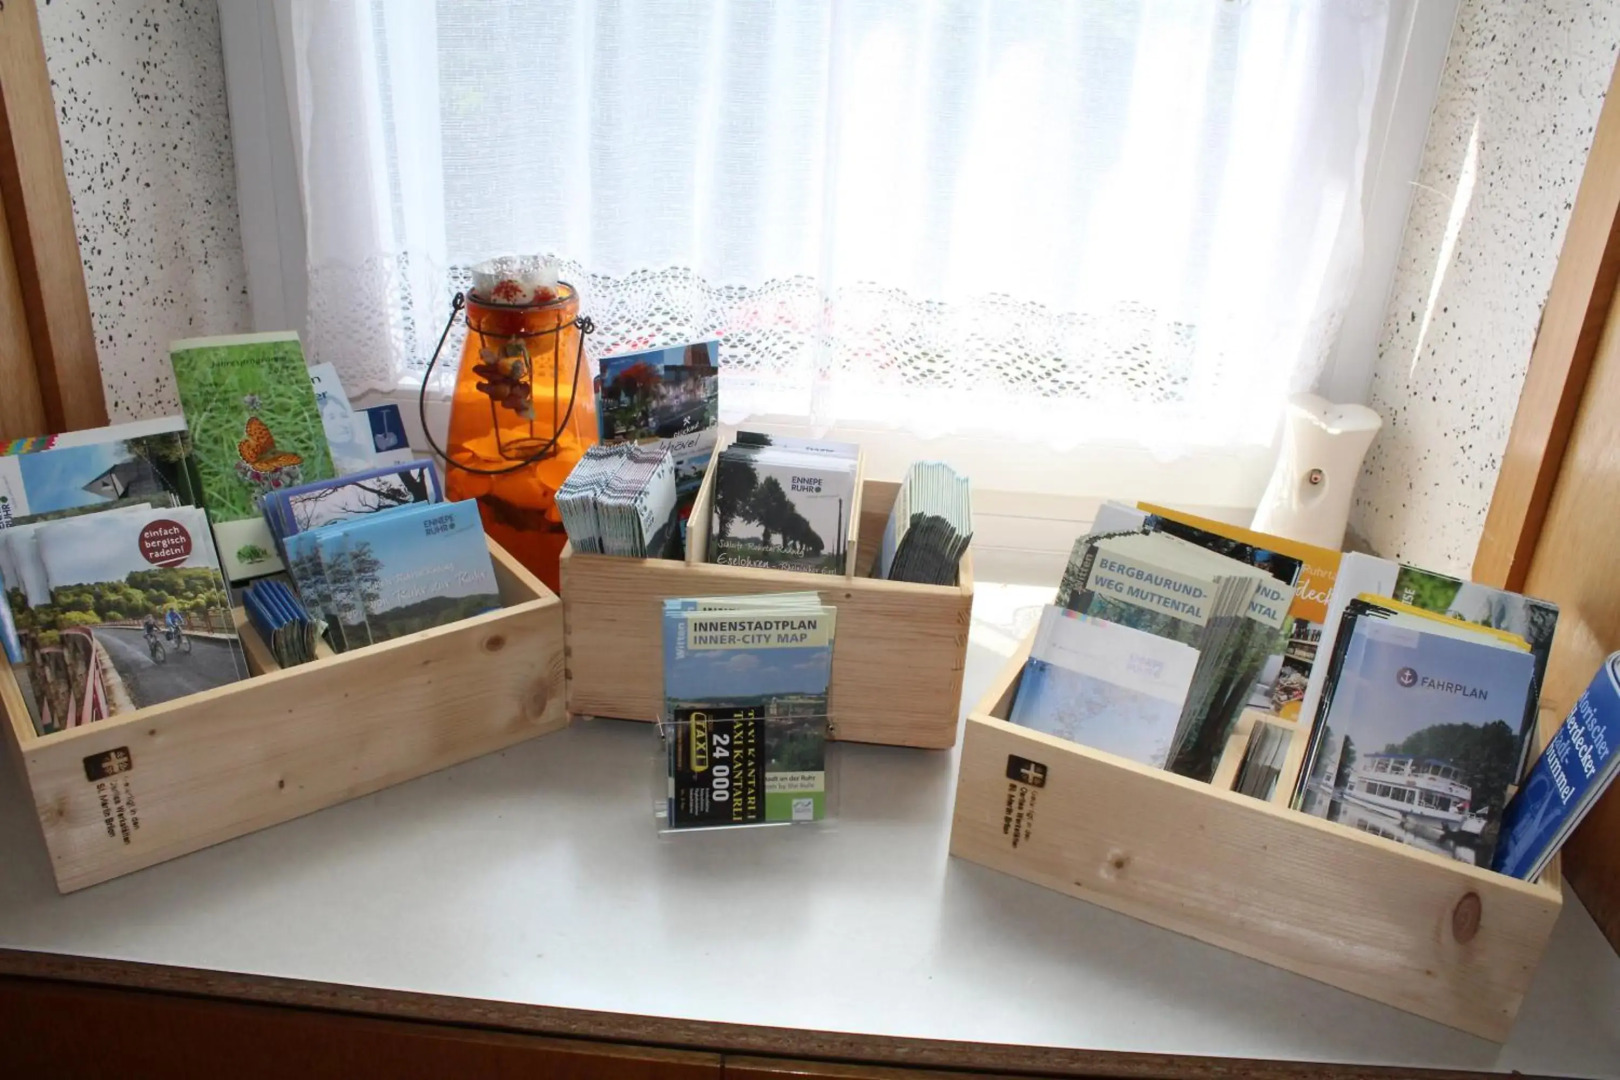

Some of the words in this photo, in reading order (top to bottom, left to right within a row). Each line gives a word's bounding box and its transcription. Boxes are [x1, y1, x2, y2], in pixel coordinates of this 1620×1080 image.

[791, 475, 823, 486] ENNEPE
[791, 484, 814, 493] RUHR
[423, 514, 454, 528] ENNEPE
[144, 526, 180, 538] einfach
[425, 524, 448, 536] RUHR
[144, 535, 187, 549] bergisch
[149, 545, 185, 559] radeln!
[717, 553, 769, 569] Eselohren
[1100, 558, 1207, 599] BERGBAURUND-
[1095, 575, 1124, 593] WEG
[1127, 586, 1202, 618] MUTTENTAL
[694, 620, 817, 632] INNENSTADTPLAN
[675, 622, 685, 660] Witten
[694, 634, 771, 645] INNER-CITY
[777, 633, 808, 643] MAP
[1421, 676, 1488, 700] FAHRPLAN
[733, 711, 744, 744] TAXI
[696, 721, 706, 759] TAXI
[712, 734, 730, 758] 24
[712, 765, 730, 801] 000
[733, 749, 743, 821] KANTARLI
